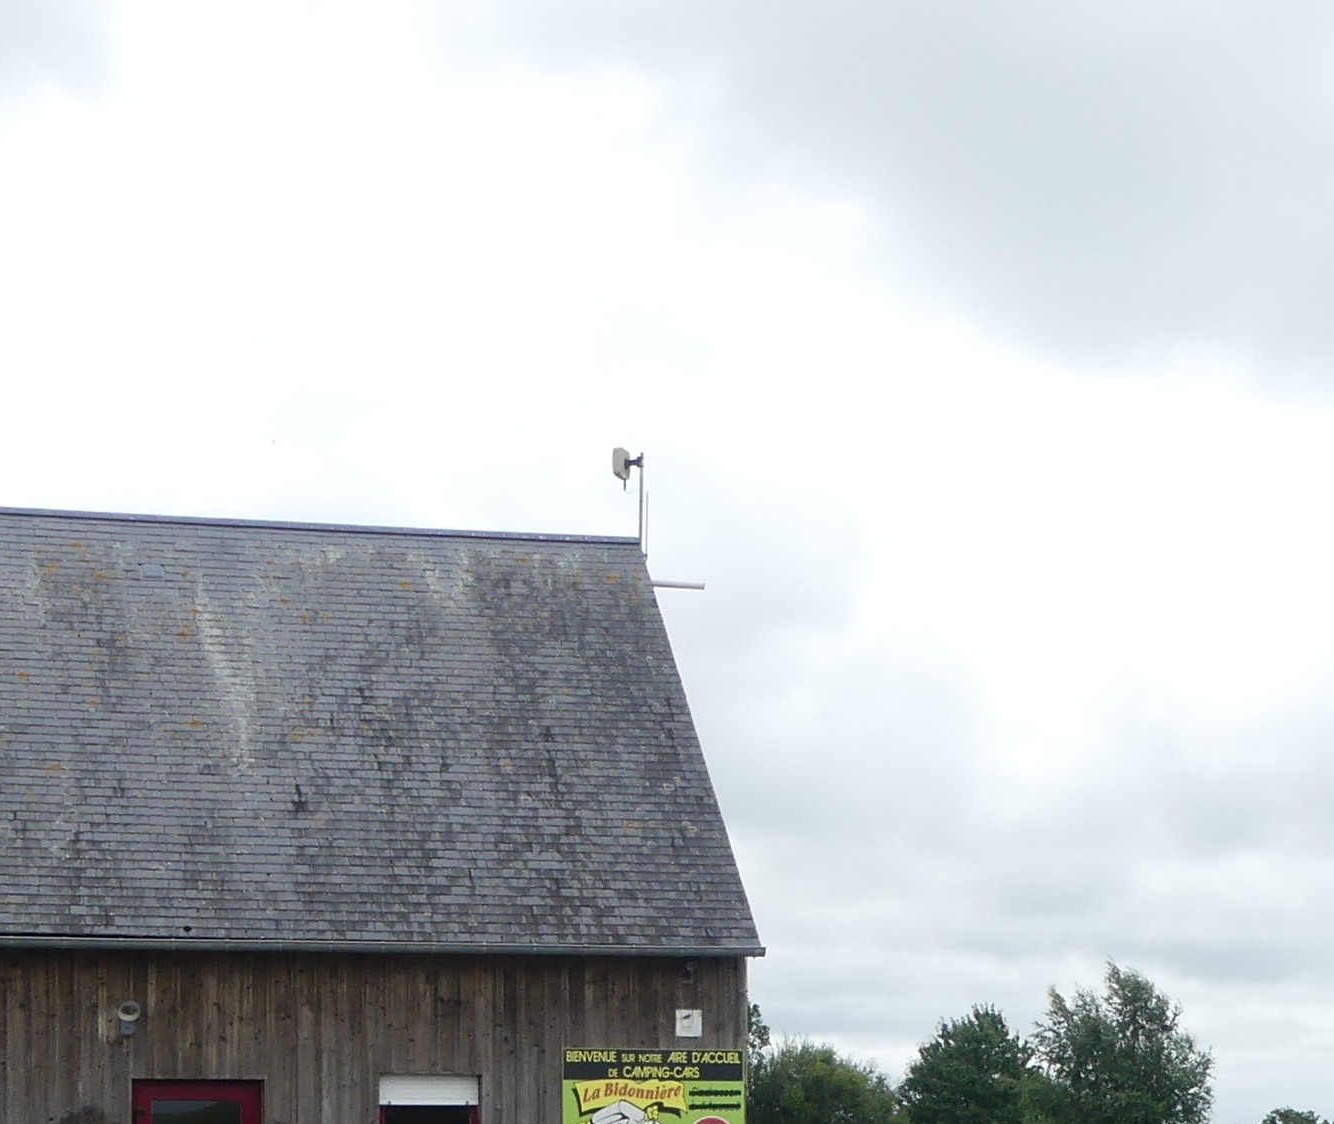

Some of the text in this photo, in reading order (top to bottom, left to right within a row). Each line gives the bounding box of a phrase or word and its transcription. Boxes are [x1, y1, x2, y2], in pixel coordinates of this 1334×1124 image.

[566, 1050, 741, 1064] BIENVENUE SUR NOTRE AIRE D'ACCUEIL
[608, 1065, 700, 1079] DE CAMPING-CARS
[582, 1086, 601, 1103] La
[603, 1081, 682, 1101] Bidonnière
